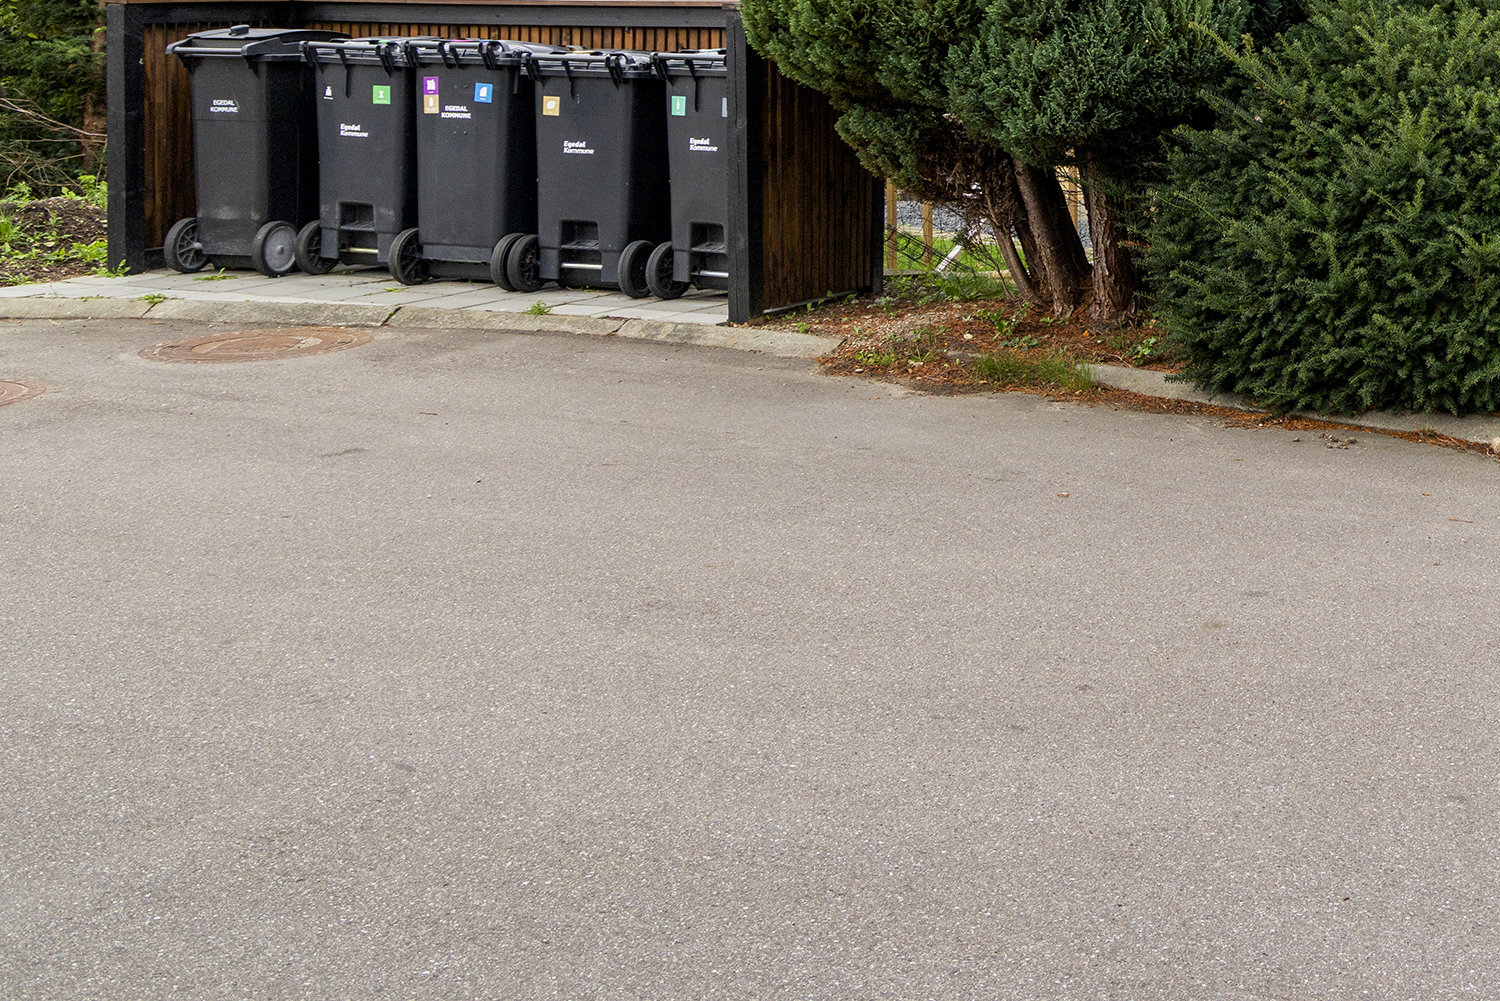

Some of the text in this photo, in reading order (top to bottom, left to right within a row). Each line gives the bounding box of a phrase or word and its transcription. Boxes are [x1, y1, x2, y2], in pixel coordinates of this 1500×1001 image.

[340, 123, 360, 131] Egedal
[340, 130, 369, 138] Kommune
[563, 140, 586, 148] Egedal
[689, 137, 710, 145] Egedal
[563, 147, 595, 155] Kommune
[689, 144, 718, 152] Kommune
